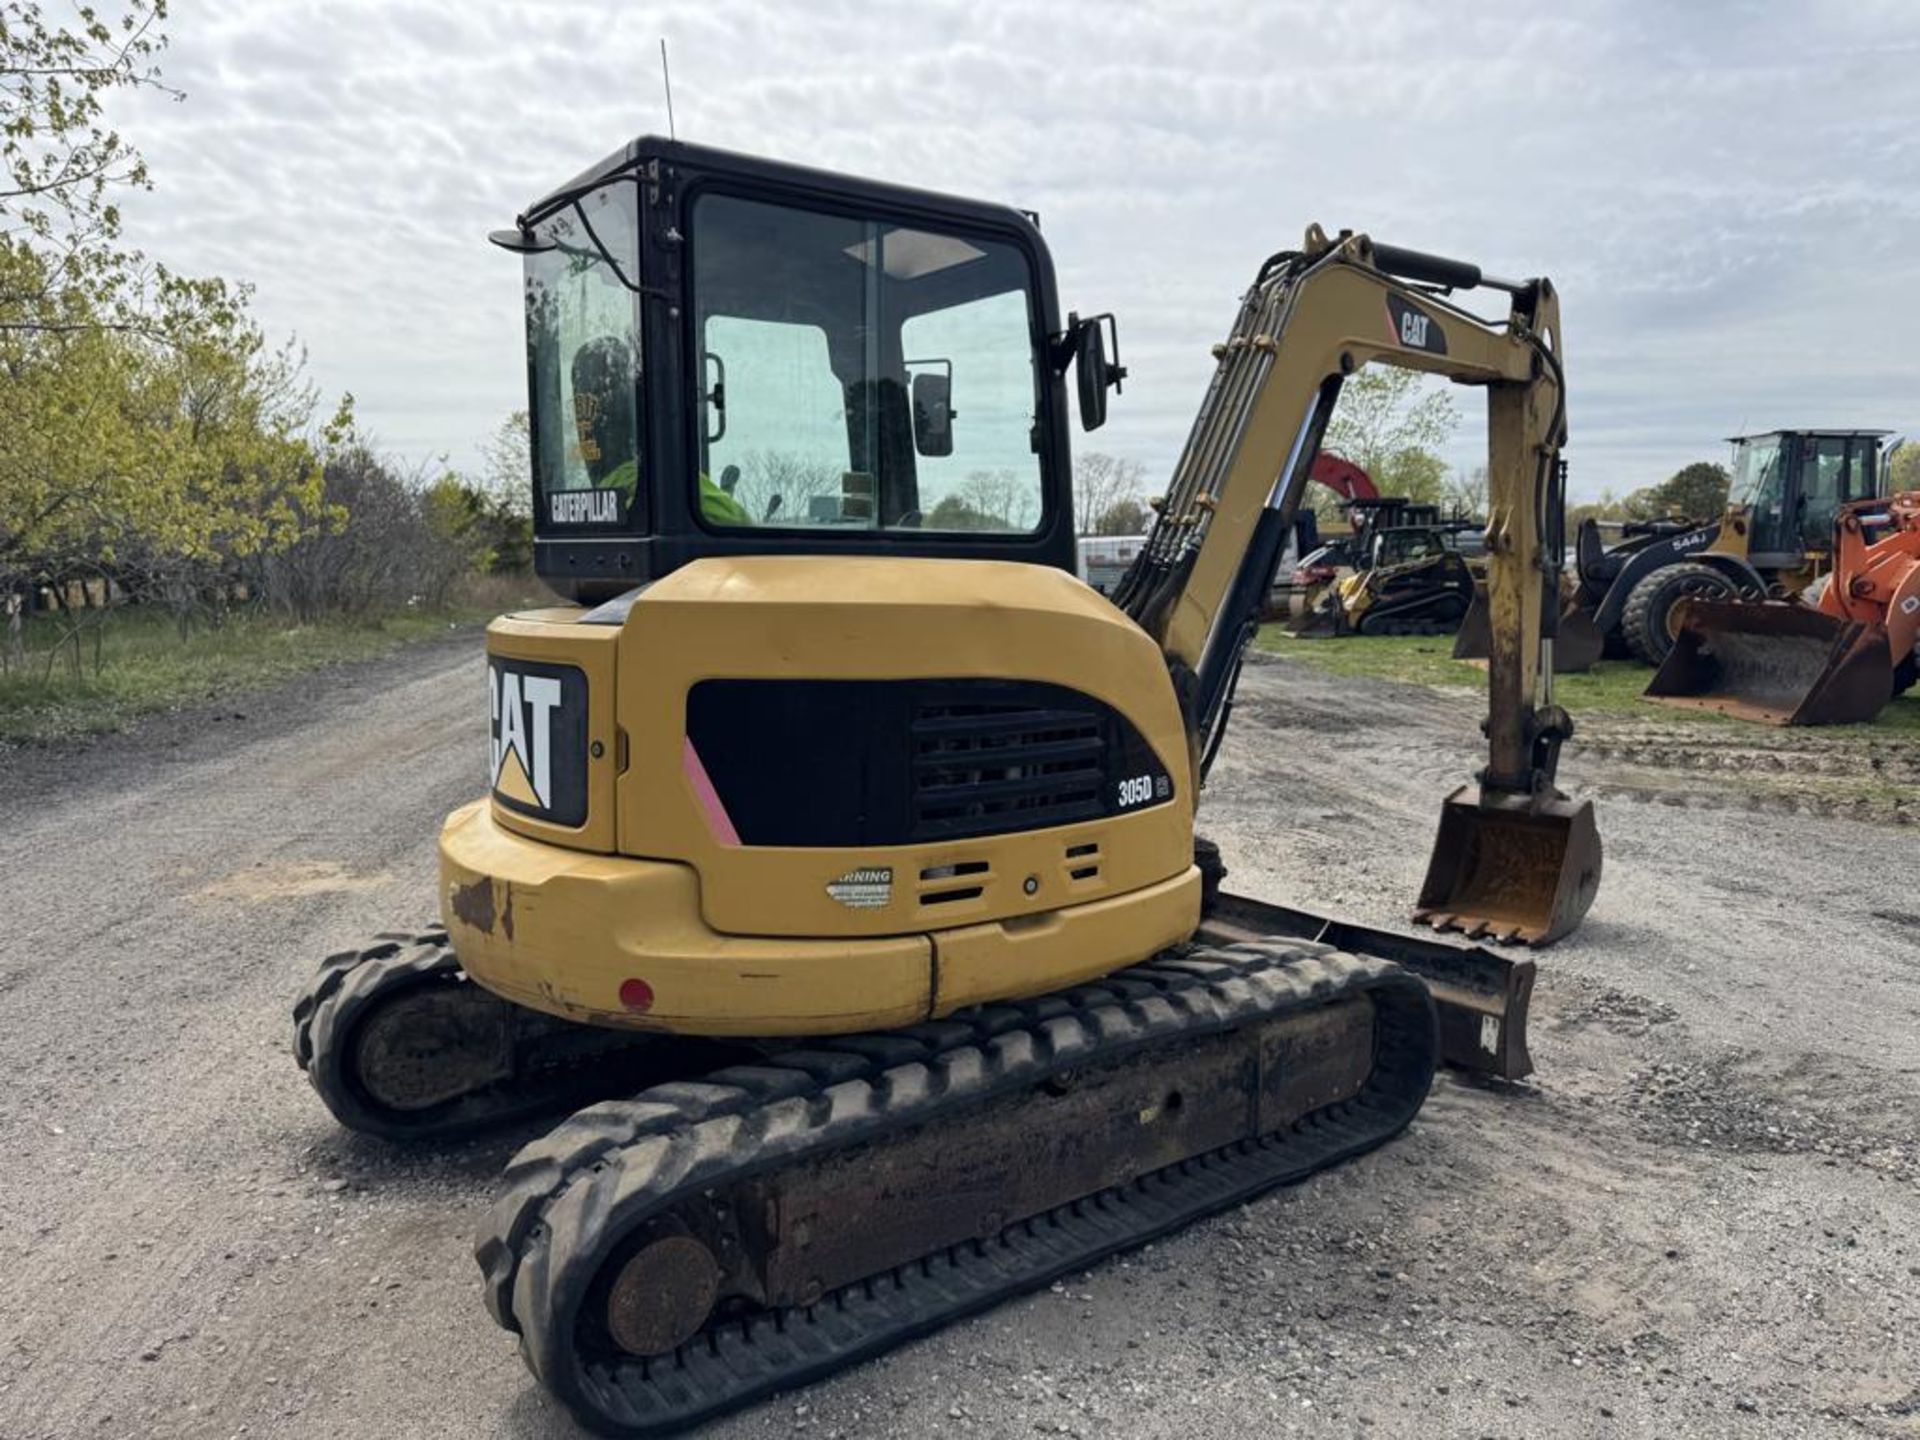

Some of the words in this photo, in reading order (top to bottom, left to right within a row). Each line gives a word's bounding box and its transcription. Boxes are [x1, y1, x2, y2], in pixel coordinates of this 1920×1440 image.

[1402, 311, 1429, 347] CAT
[551, 490, 618, 523] CATERPILLAR
[488, 665, 562, 810] CAT
[1119, 774, 1152, 807] 305D
[840, 870, 891, 883] RNING
